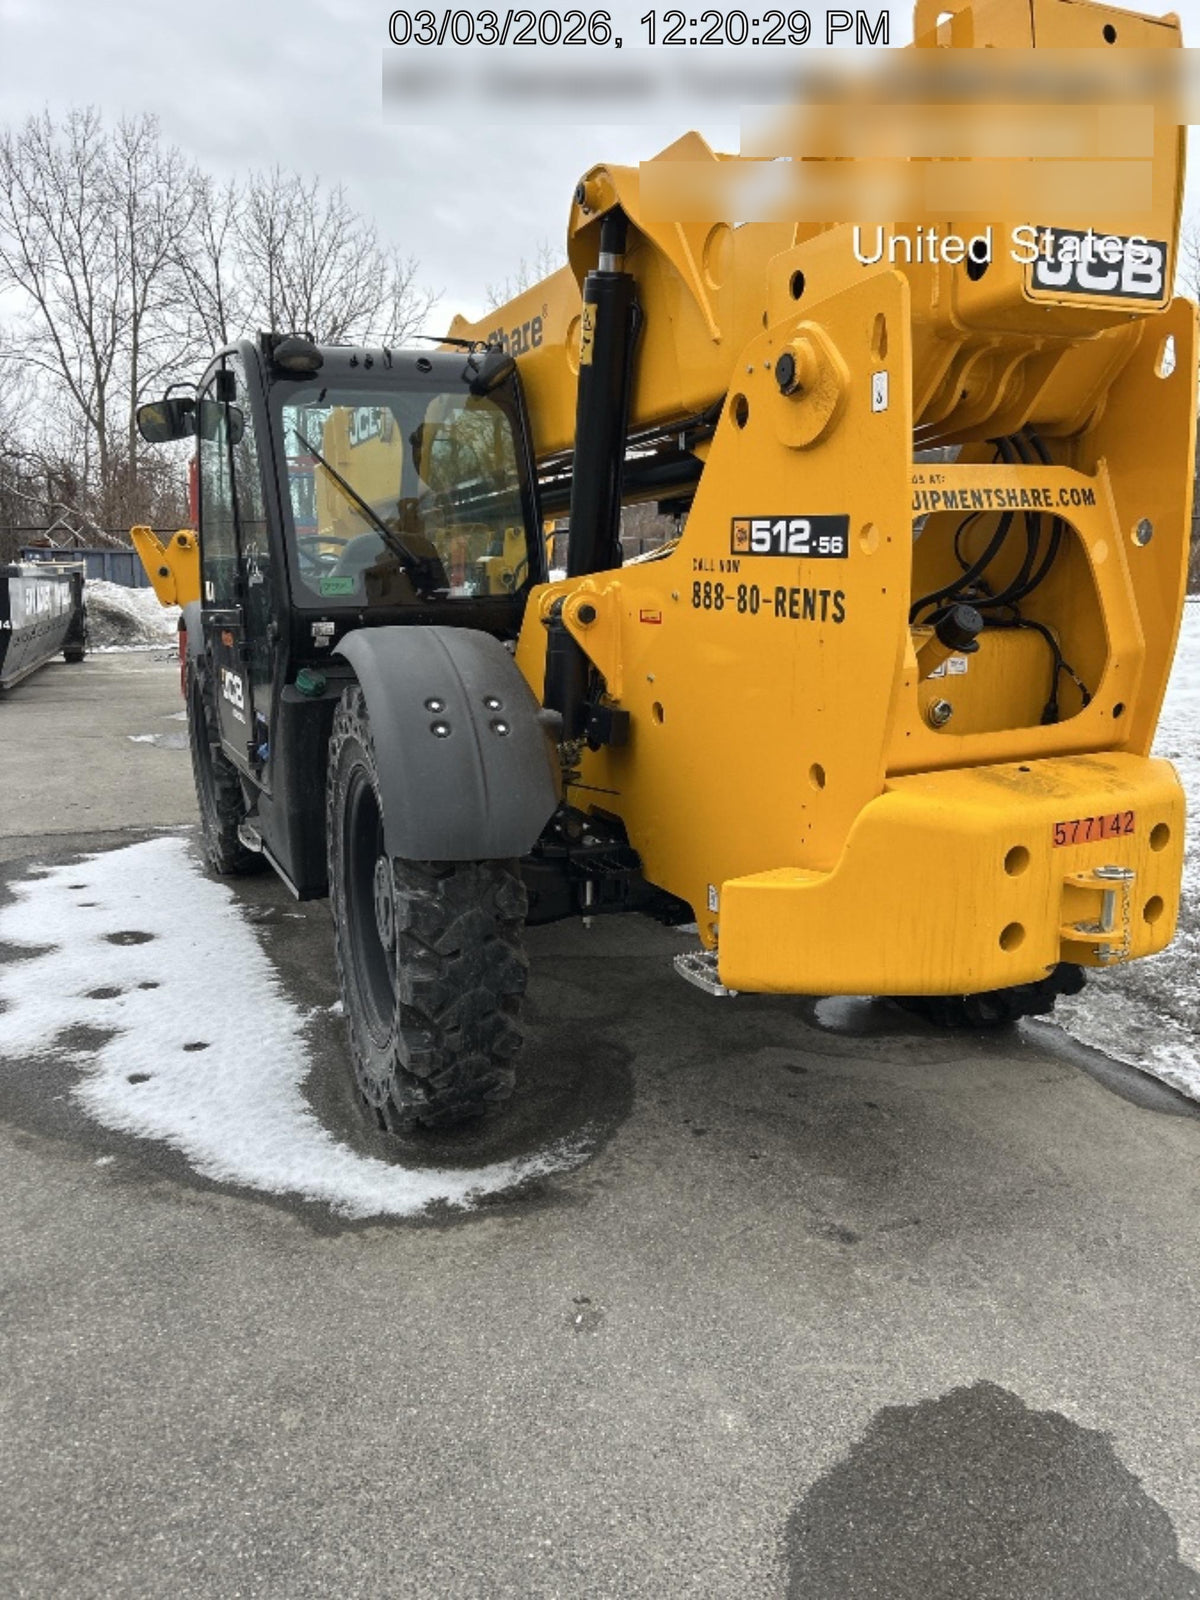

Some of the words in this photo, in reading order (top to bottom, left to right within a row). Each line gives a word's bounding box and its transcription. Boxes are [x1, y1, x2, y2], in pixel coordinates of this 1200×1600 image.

[1036, 236, 1162, 294] JCB
[693, 558, 715, 572] CALL
[719, 560, 740, 573] NOW
[692, 581, 846, 624] 888-80-RENTS
[1054, 810, 1135, 846] 577142
